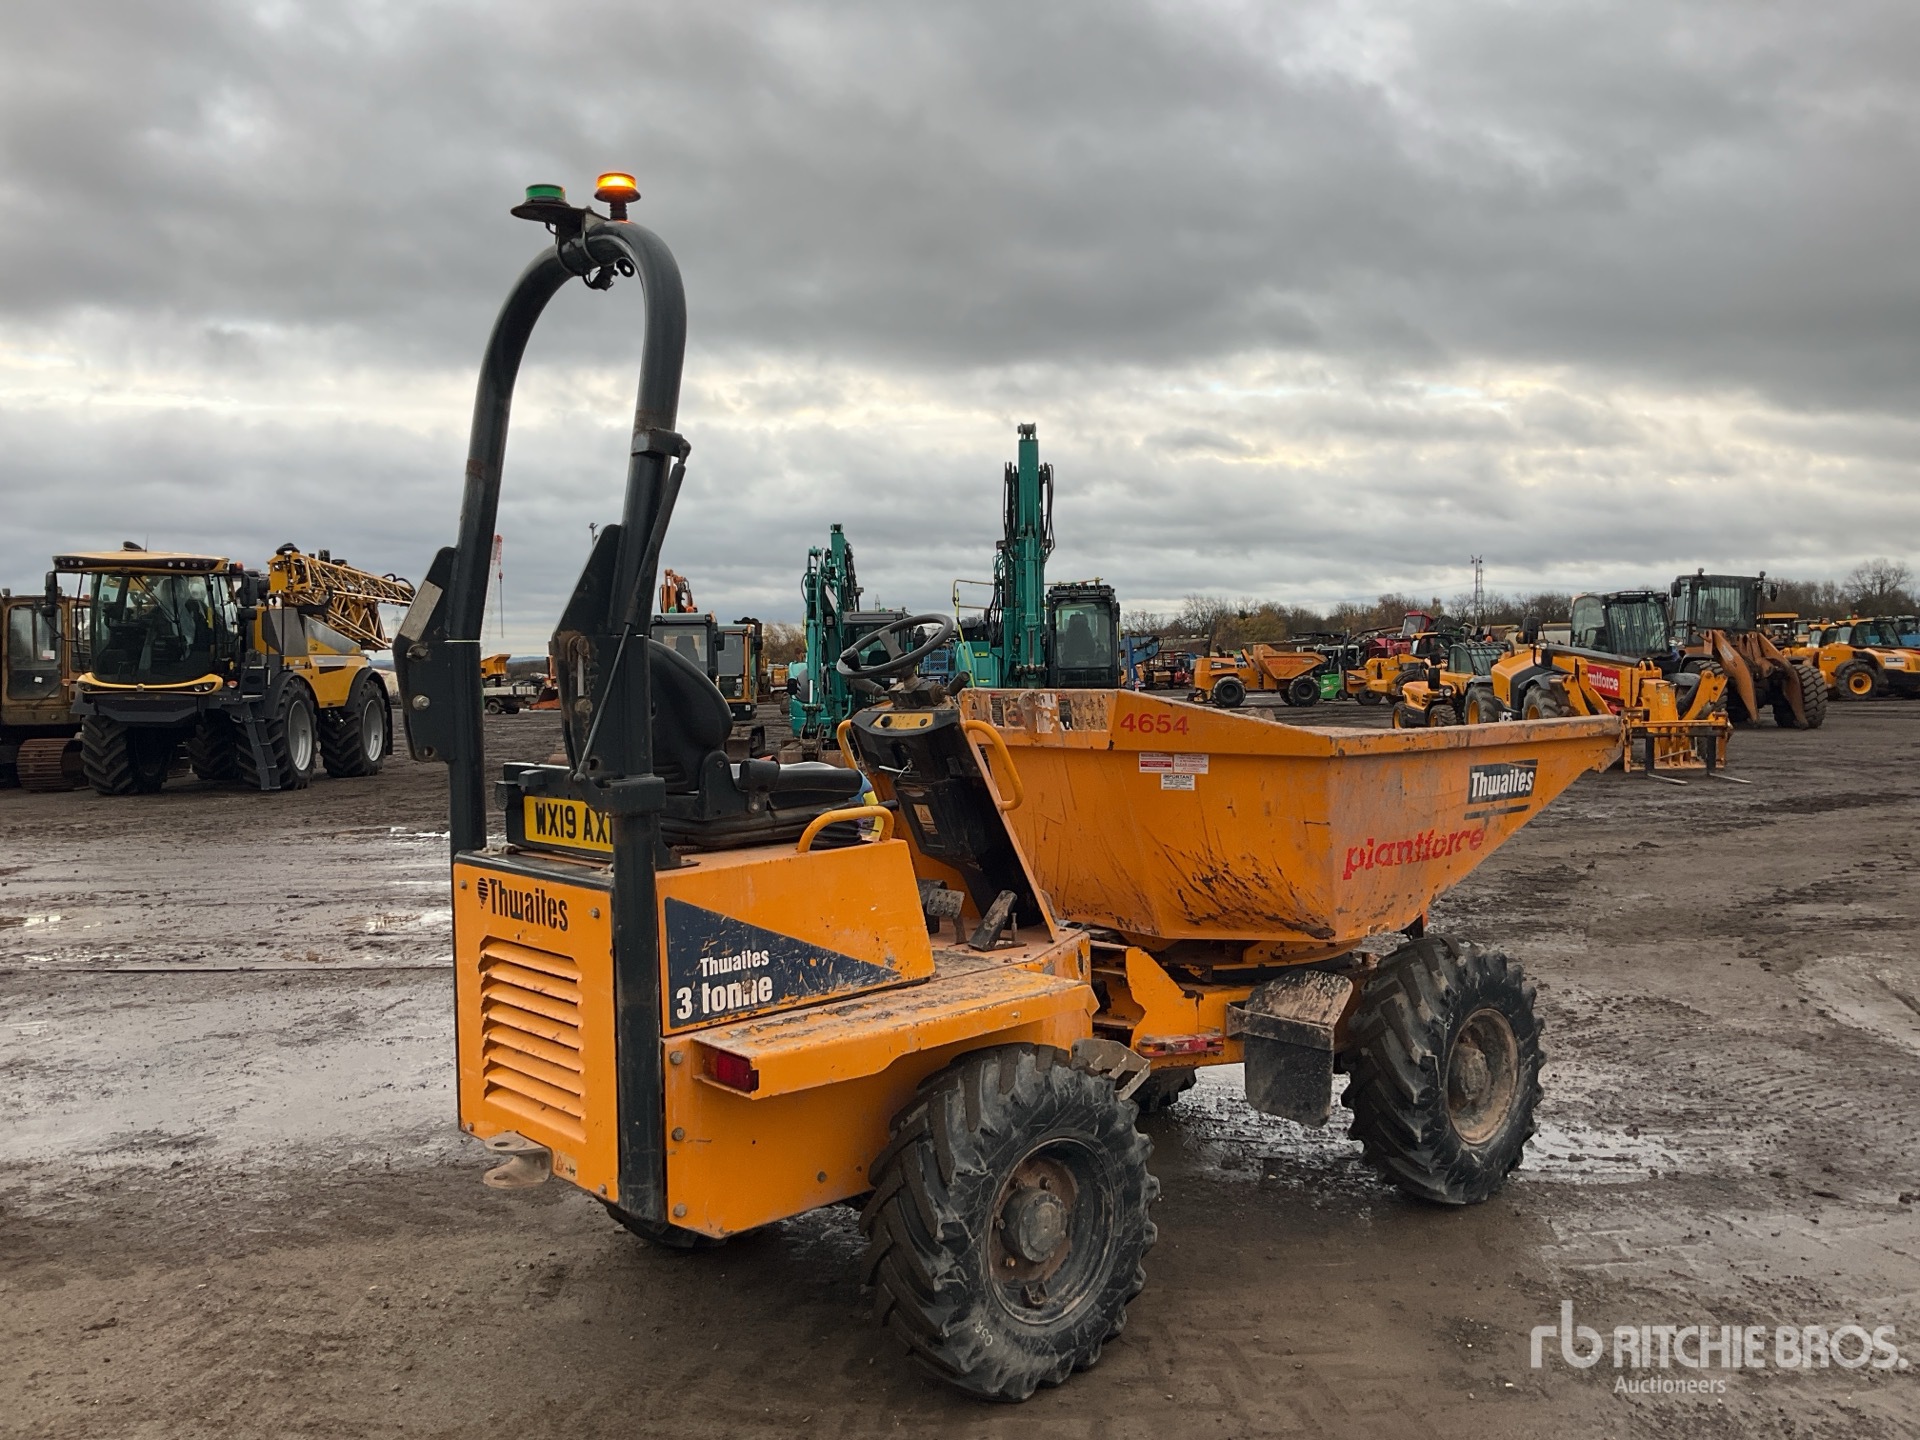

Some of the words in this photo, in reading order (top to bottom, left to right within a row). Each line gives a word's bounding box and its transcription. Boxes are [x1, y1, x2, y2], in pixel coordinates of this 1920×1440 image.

[1120, 713, 1189, 735] 4654
[1471, 769, 1534, 798] Thwaites
[535, 802, 577, 839] WX19
[489, 878, 568, 932] Thwaites
[700, 950, 770, 977] Thwaites
[676, 987, 693, 1020] 3
[702, 976, 773, 1014] tonne
